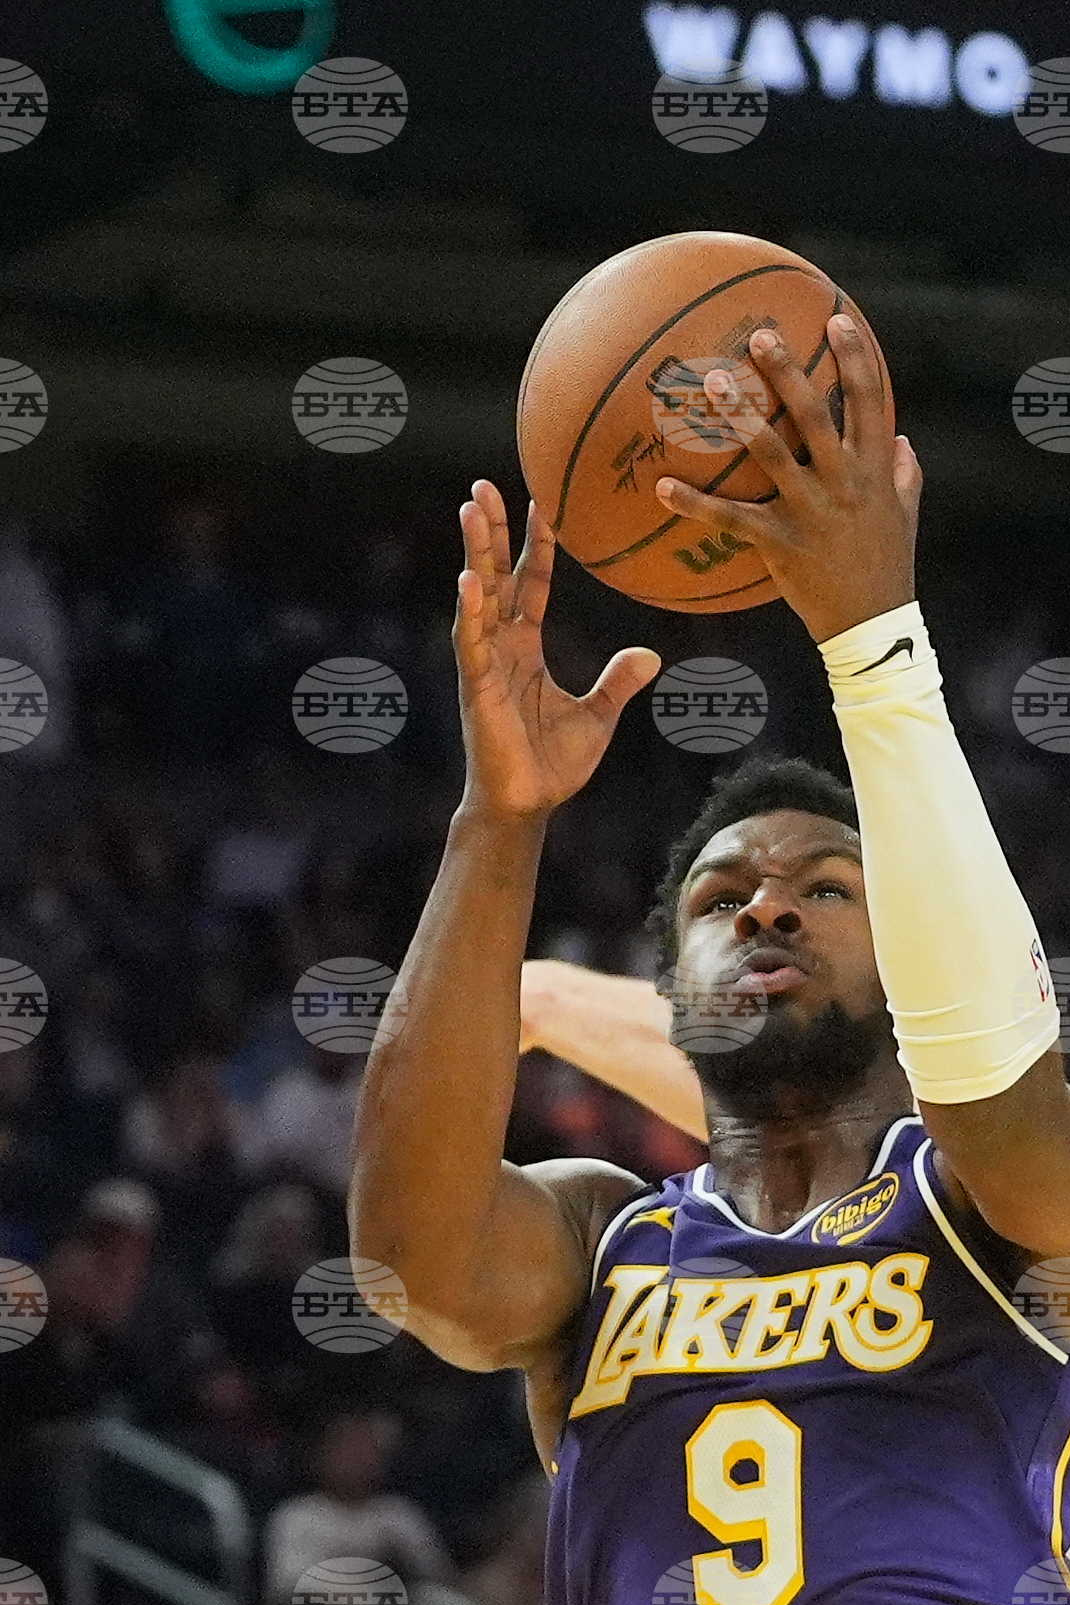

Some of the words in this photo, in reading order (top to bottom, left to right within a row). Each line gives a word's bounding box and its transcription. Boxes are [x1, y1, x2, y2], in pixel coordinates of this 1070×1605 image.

[643, 2, 1030, 117] WAYMO
[821, 1184, 894, 1233] bibigo
[569, 1252, 934, 1420] LAKERS
